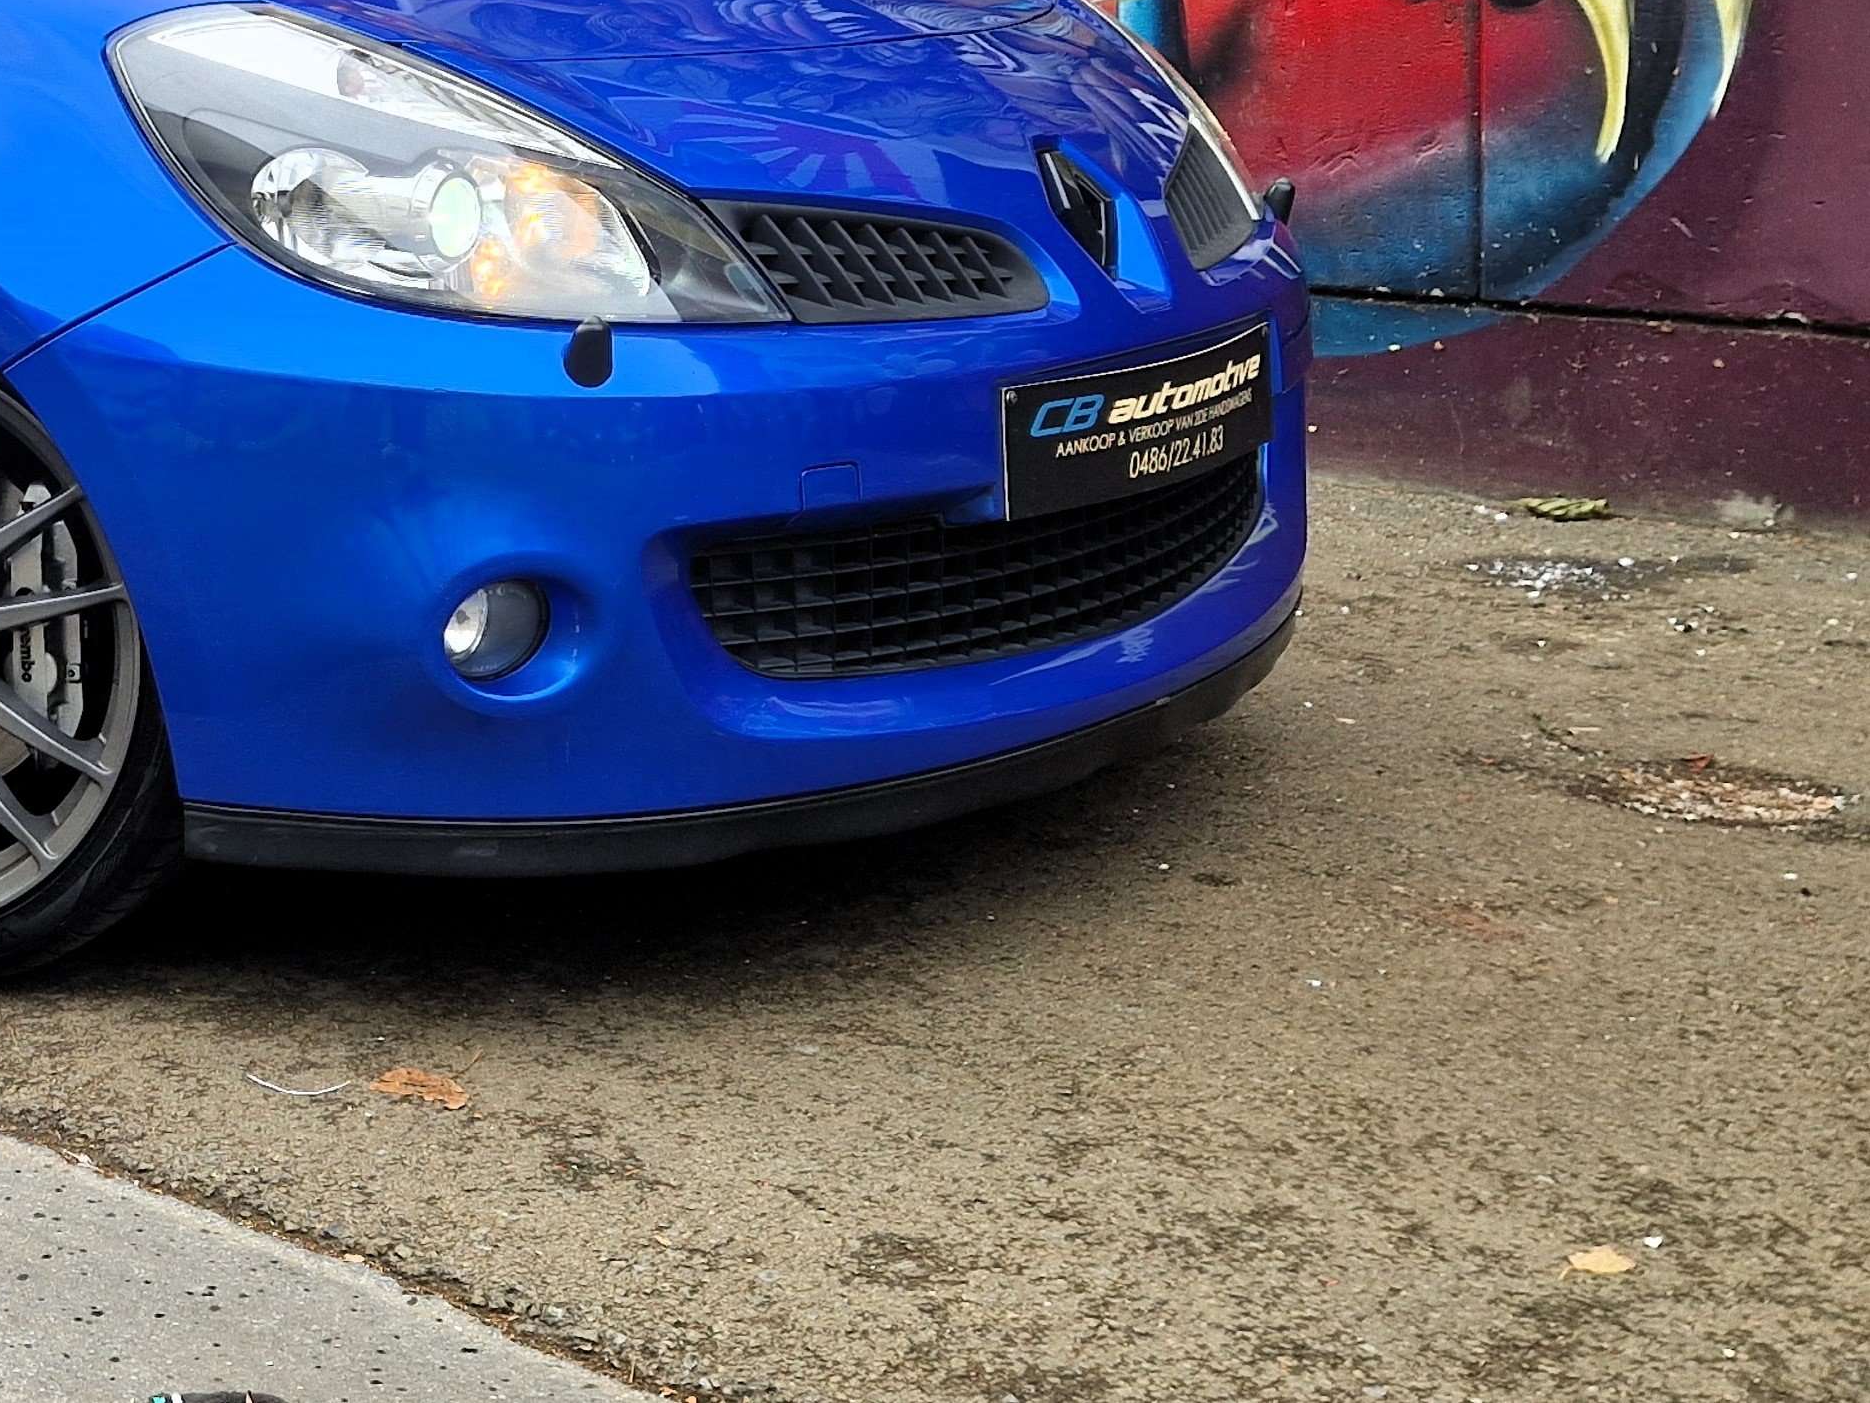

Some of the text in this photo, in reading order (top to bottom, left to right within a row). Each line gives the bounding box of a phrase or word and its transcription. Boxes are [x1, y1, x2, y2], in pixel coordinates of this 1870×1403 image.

[1029, 353, 1261, 437] CB automotive
[1055, 432, 1116, 459] AANKOOP
[1117, 431, 1126, 446] &
[1128, 419, 1175, 445] VERKOOP
[1175, 412, 1194, 431] VAN
[1129, 424, 1225, 479] 0486/22.41.83
